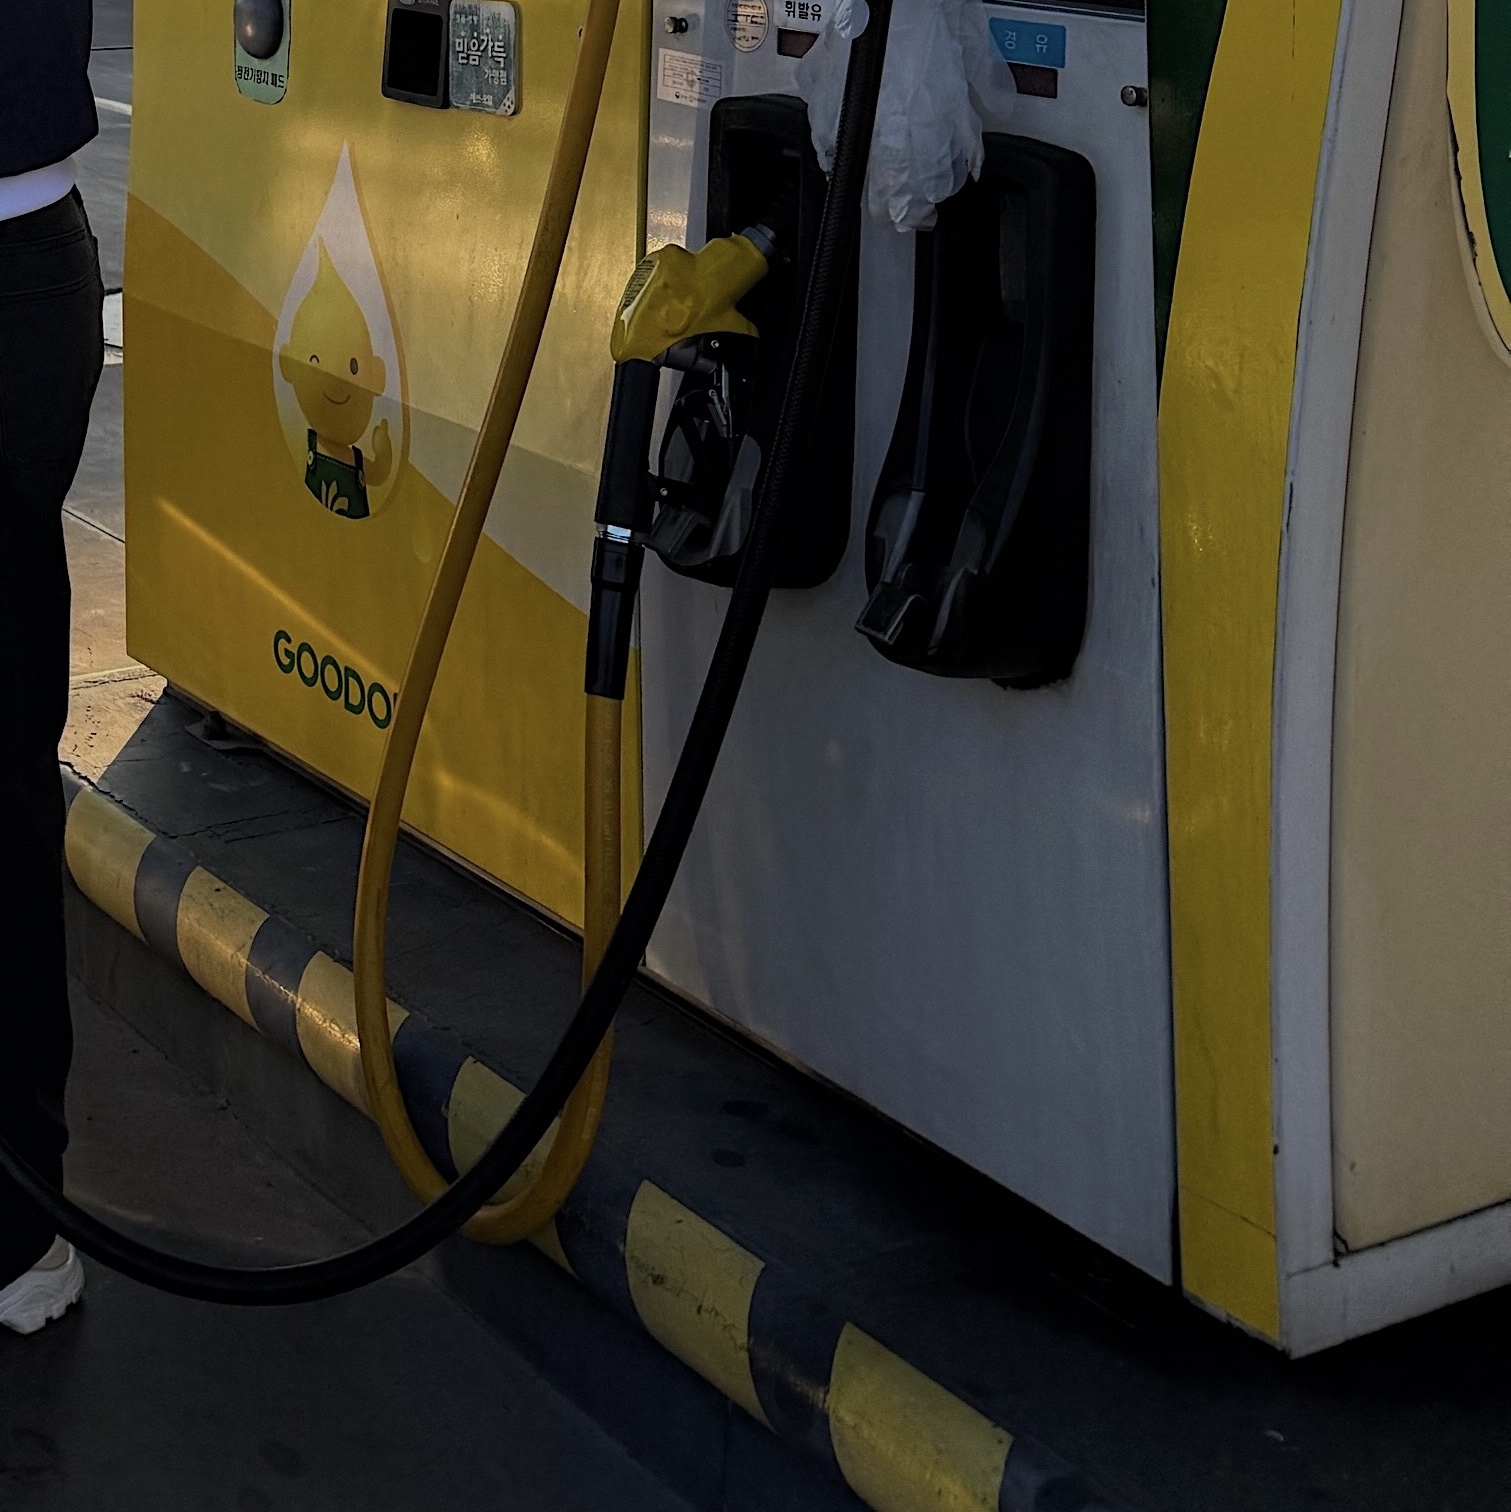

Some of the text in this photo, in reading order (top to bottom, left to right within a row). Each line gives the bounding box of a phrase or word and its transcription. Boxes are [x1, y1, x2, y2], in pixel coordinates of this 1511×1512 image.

[785, 0, 822, 22] 휘발유
[455, 31, 507, 68] 믿음가득
[484, 67, 507, 86] 가맹점
[273, 629, 398, 729] GOODO
